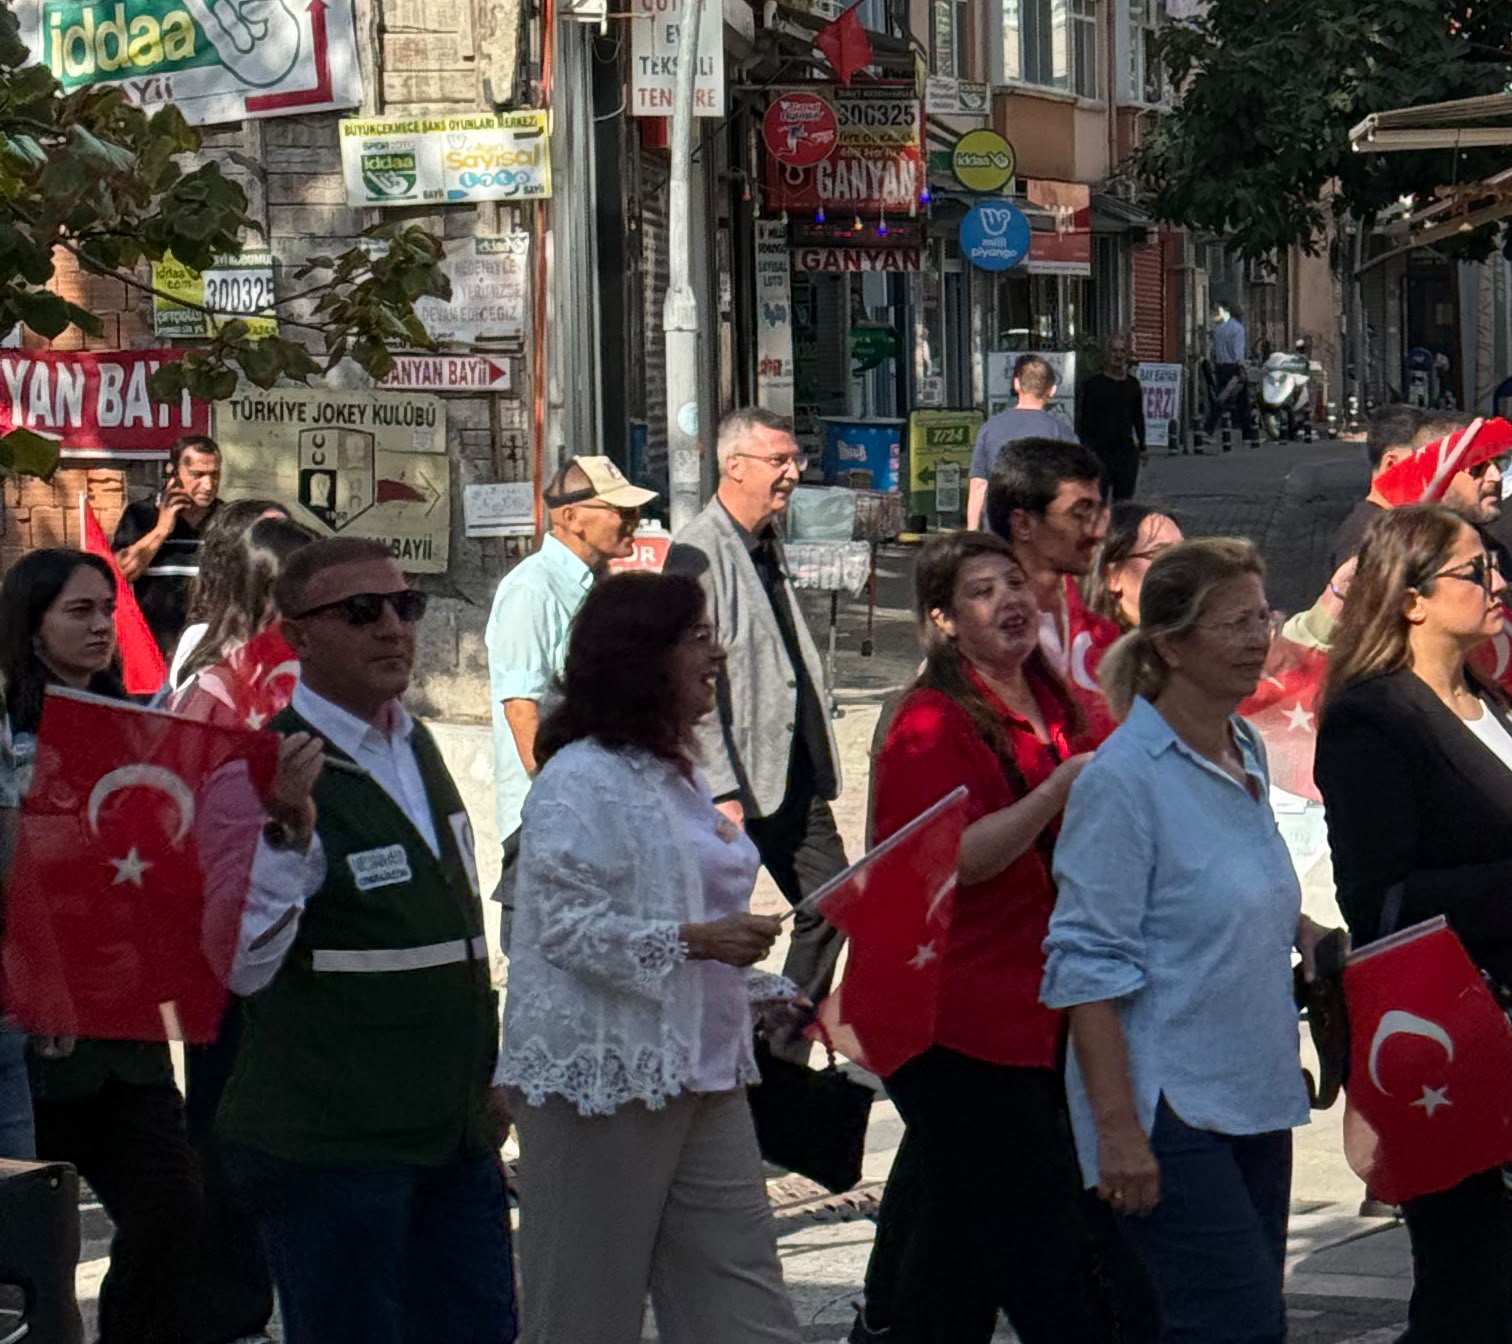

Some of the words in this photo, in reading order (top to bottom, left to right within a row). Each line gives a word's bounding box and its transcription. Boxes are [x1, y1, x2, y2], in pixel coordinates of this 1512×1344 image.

[50, 2, 197, 79] iddaa
[638, 87, 716, 107] TENRE
[816, 158, 917, 203] GANYAN
[801, 247, 922, 272] GANYAN
[229, 392, 308, 424] TÜRKİYE
[312, 400, 367, 426] JOKEY
